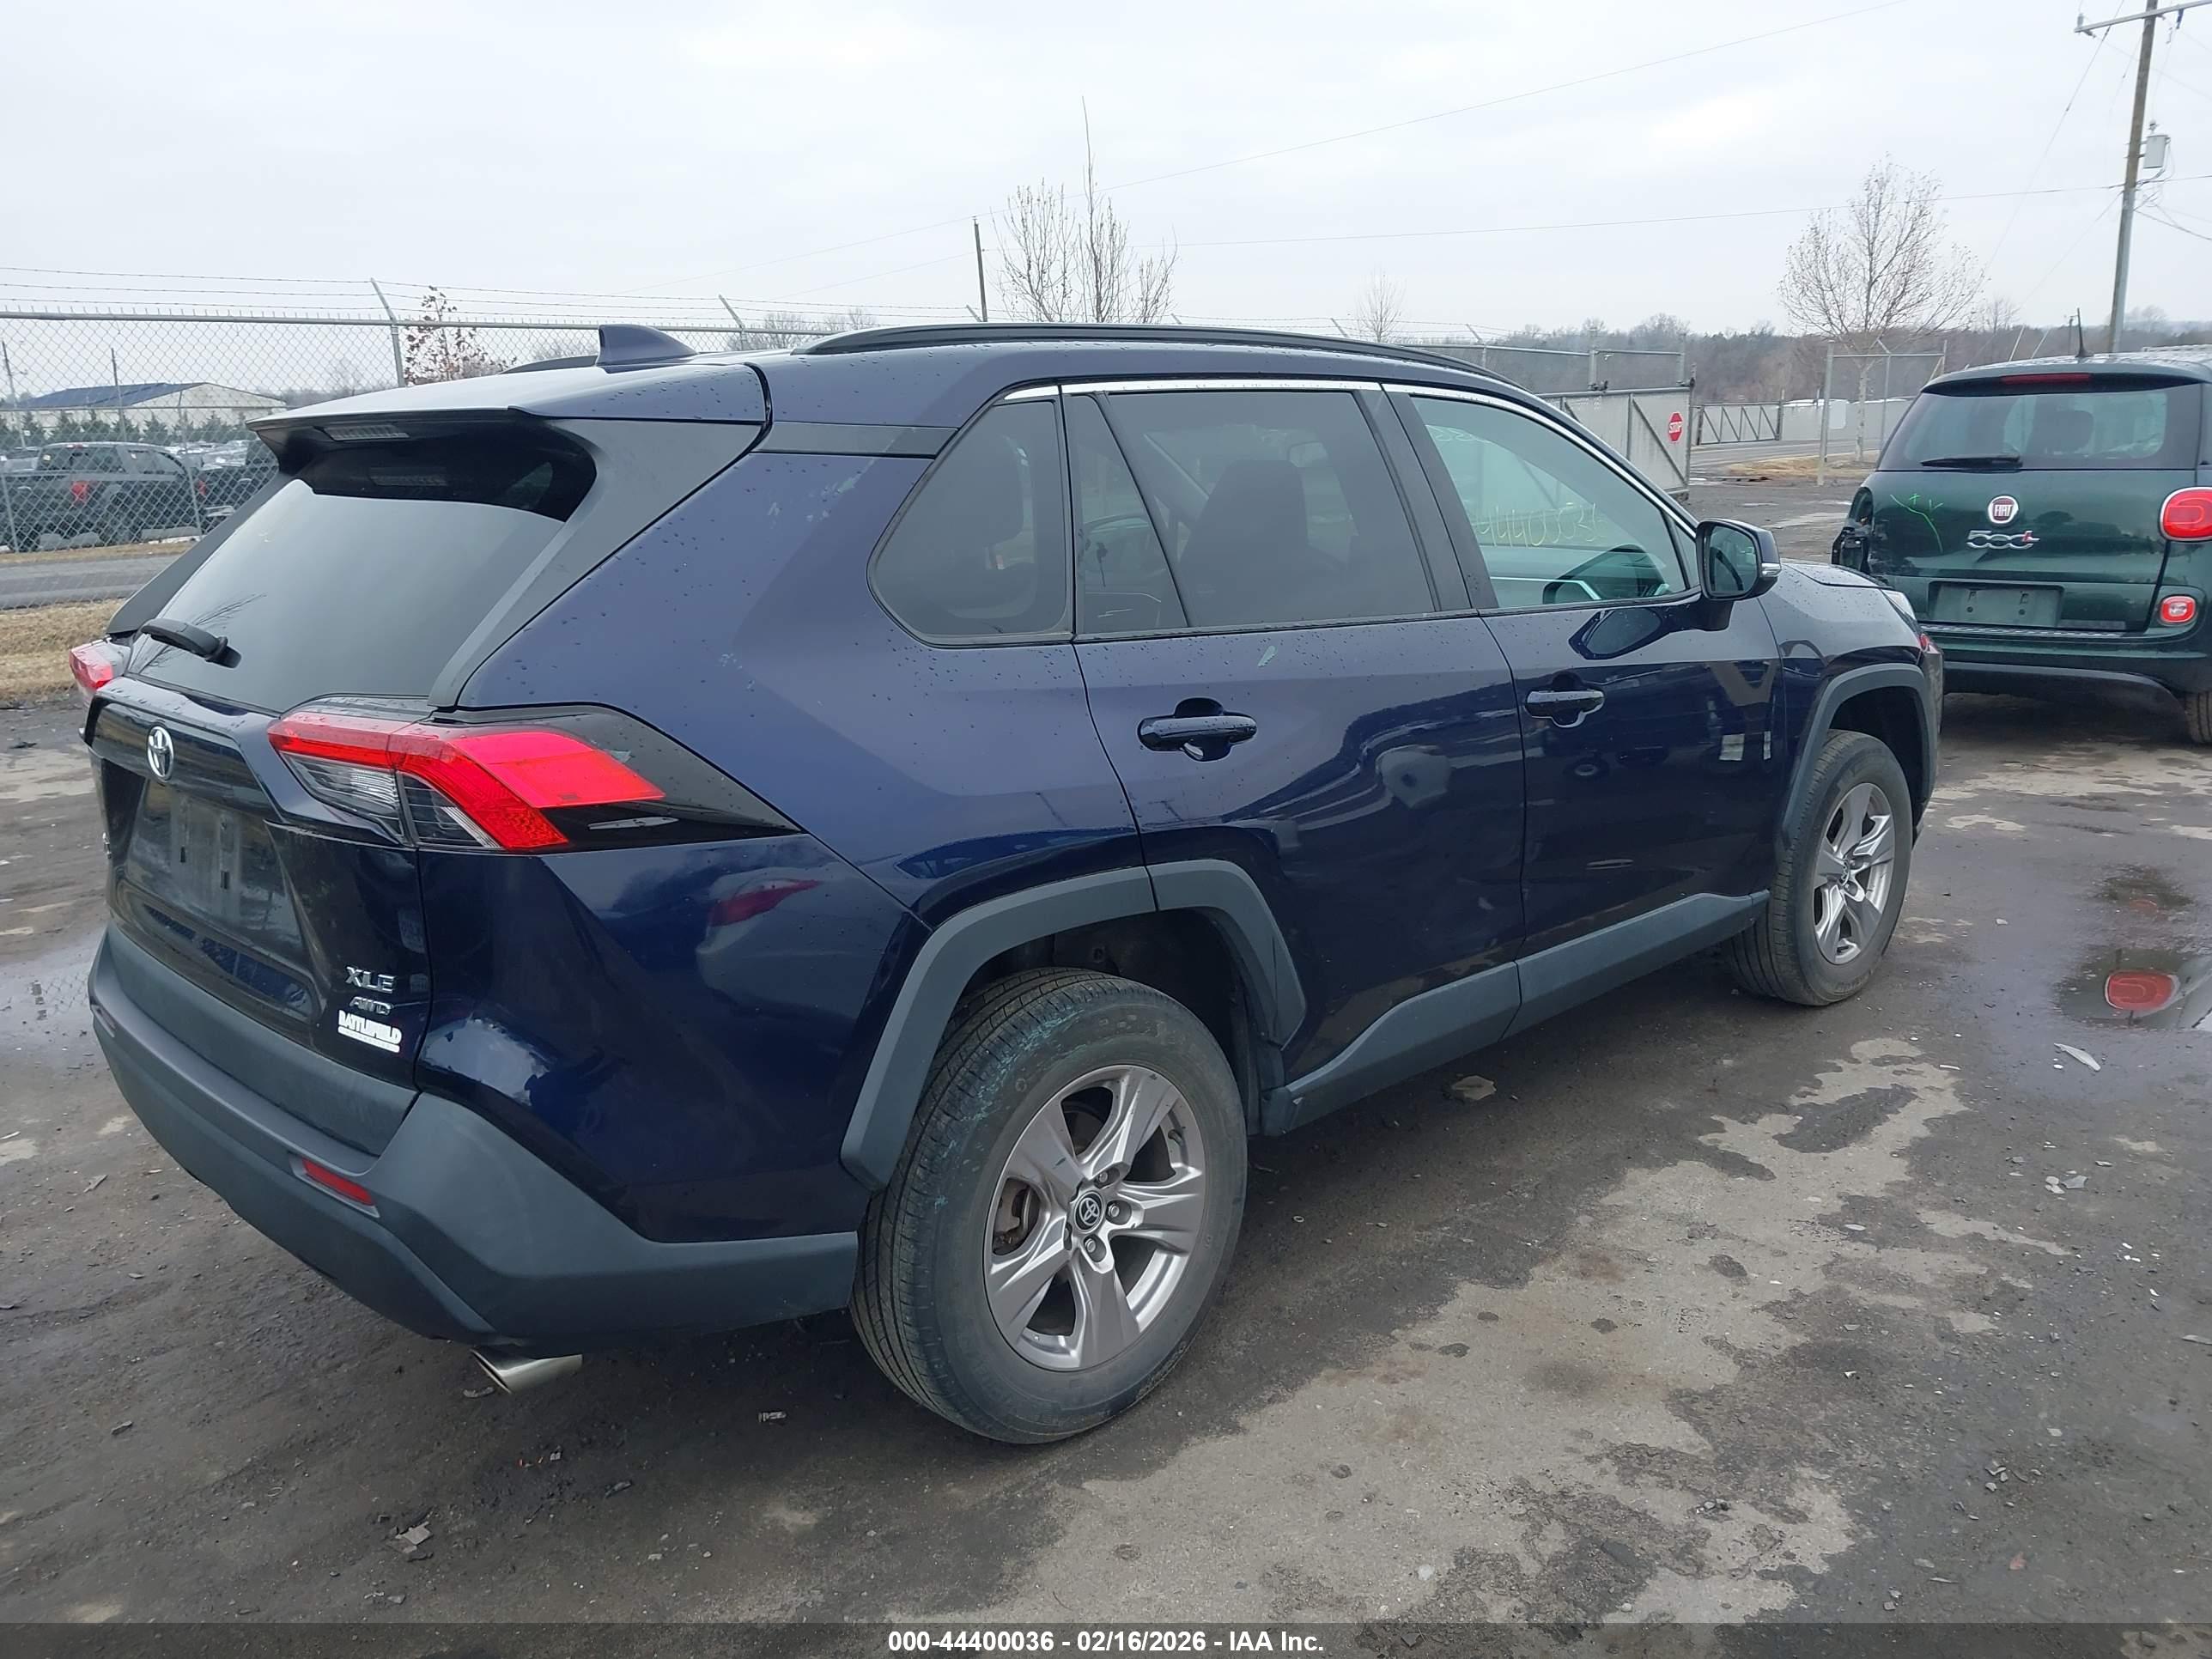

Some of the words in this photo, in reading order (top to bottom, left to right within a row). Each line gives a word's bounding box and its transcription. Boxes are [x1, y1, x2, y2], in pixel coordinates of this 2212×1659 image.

[1668, 421, 1682, 434] STOP
[1994, 504, 2014, 517] FIAT
[345, 966, 396, 994] XLE
[349, 996, 392, 1016] AWD
